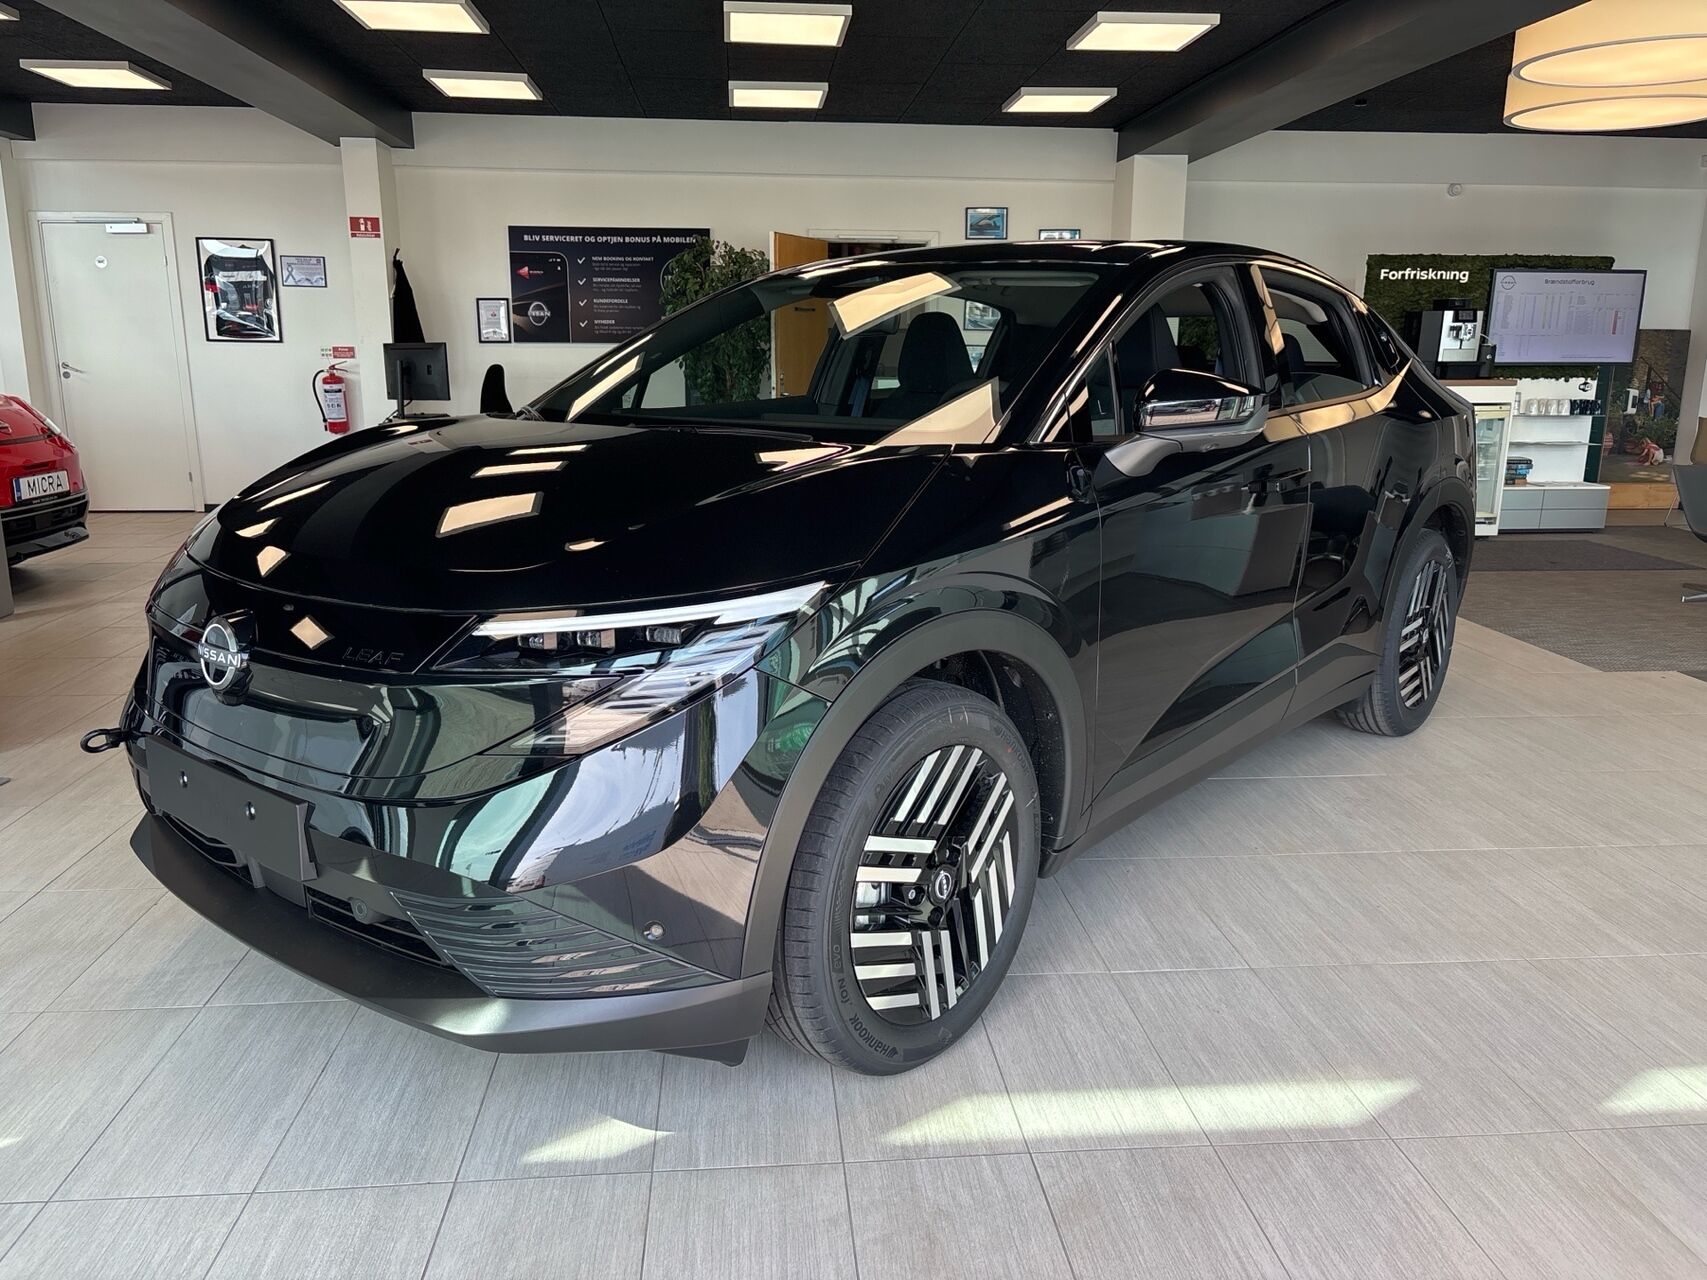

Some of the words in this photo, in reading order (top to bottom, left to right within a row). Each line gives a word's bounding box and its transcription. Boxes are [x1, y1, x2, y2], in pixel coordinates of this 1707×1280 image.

[523, 234, 540, 242] BLIV
[597, 235, 624, 244] OPTJEN
[652, 235, 662, 243] PÅ
[1380, 268, 1470, 284] Forfriskning
[27, 474, 64, 497] MICRA
[341, 646, 405, 665] LEAF
